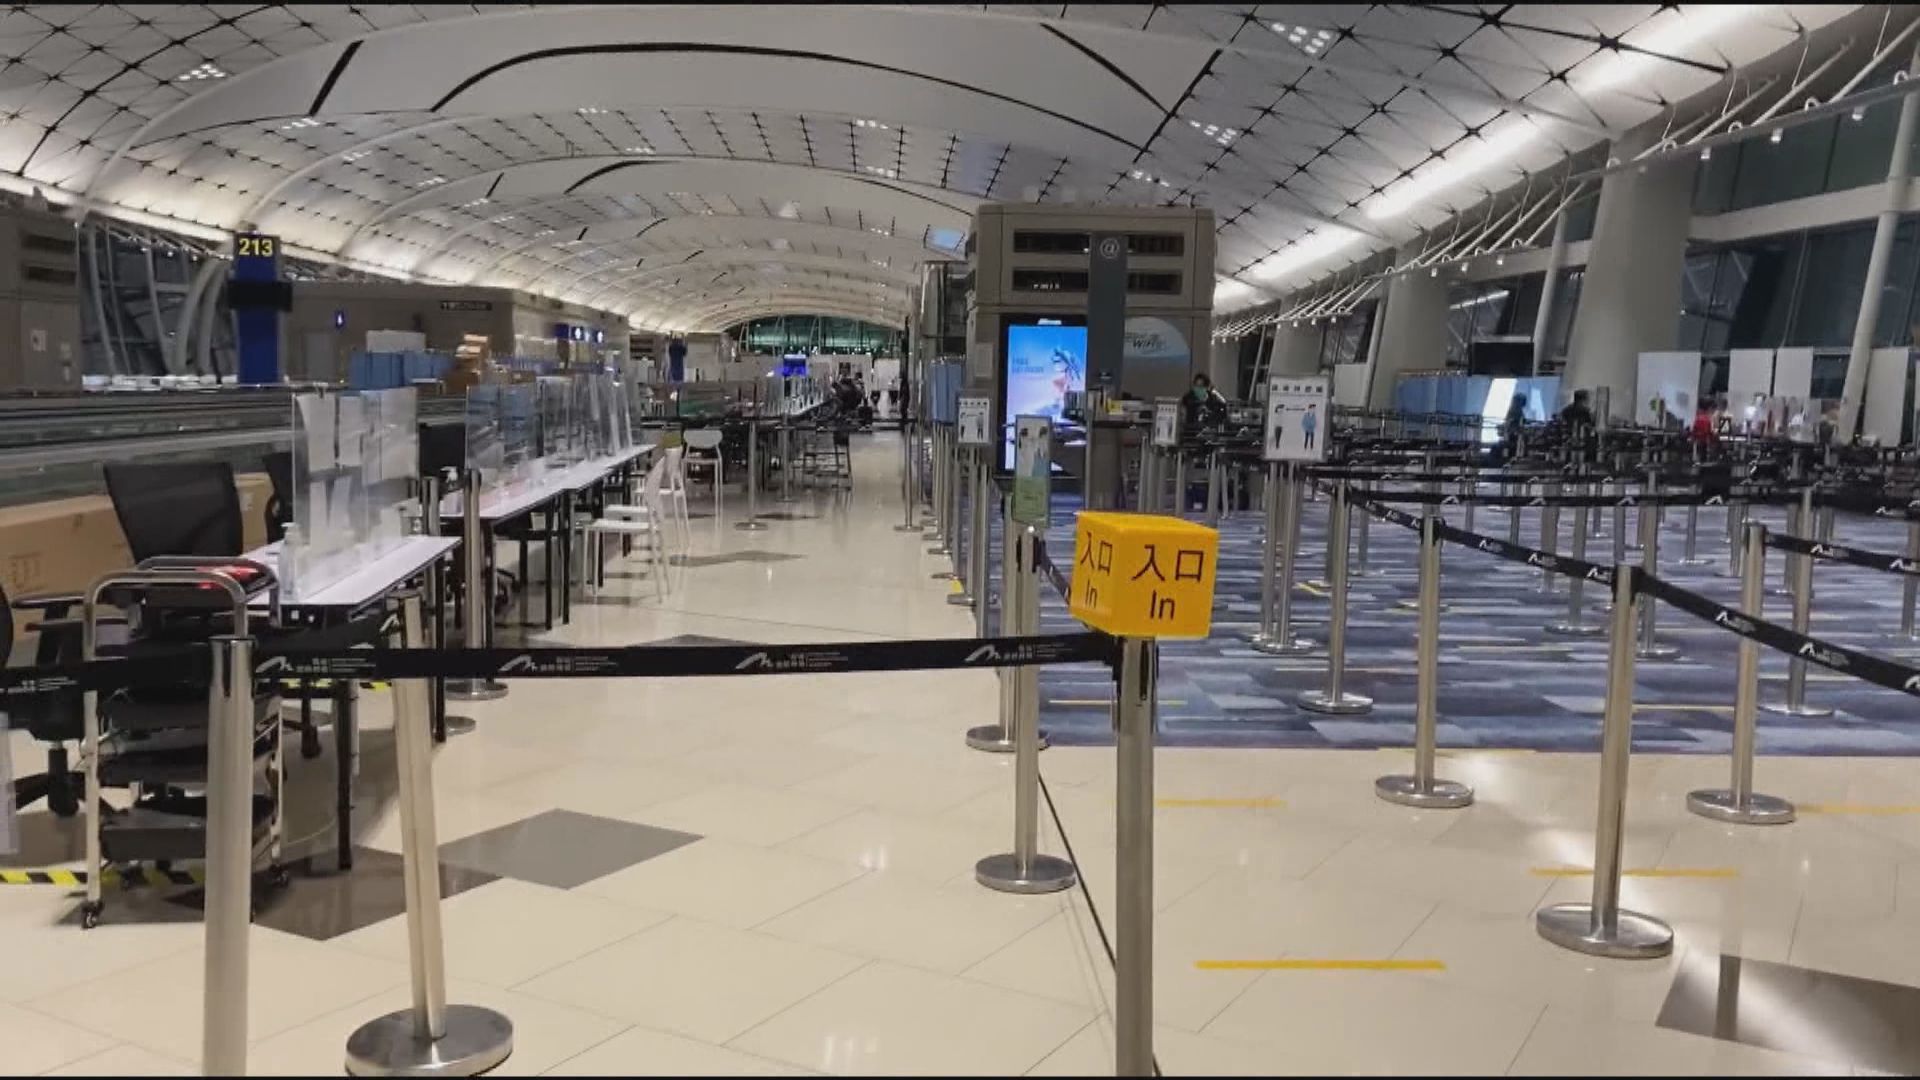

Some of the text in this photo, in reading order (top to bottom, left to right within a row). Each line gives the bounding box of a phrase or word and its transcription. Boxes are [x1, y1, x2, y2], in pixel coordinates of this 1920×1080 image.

[239, 238, 273, 257] 213
[1100, 238, 1120, 259] @
[1080, 531, 1113, 576] 入口
[1131, 544, 1204, 583] 入口
[1085, 579, 1098, 609] In
[1150, 590, 1175, 620] In
